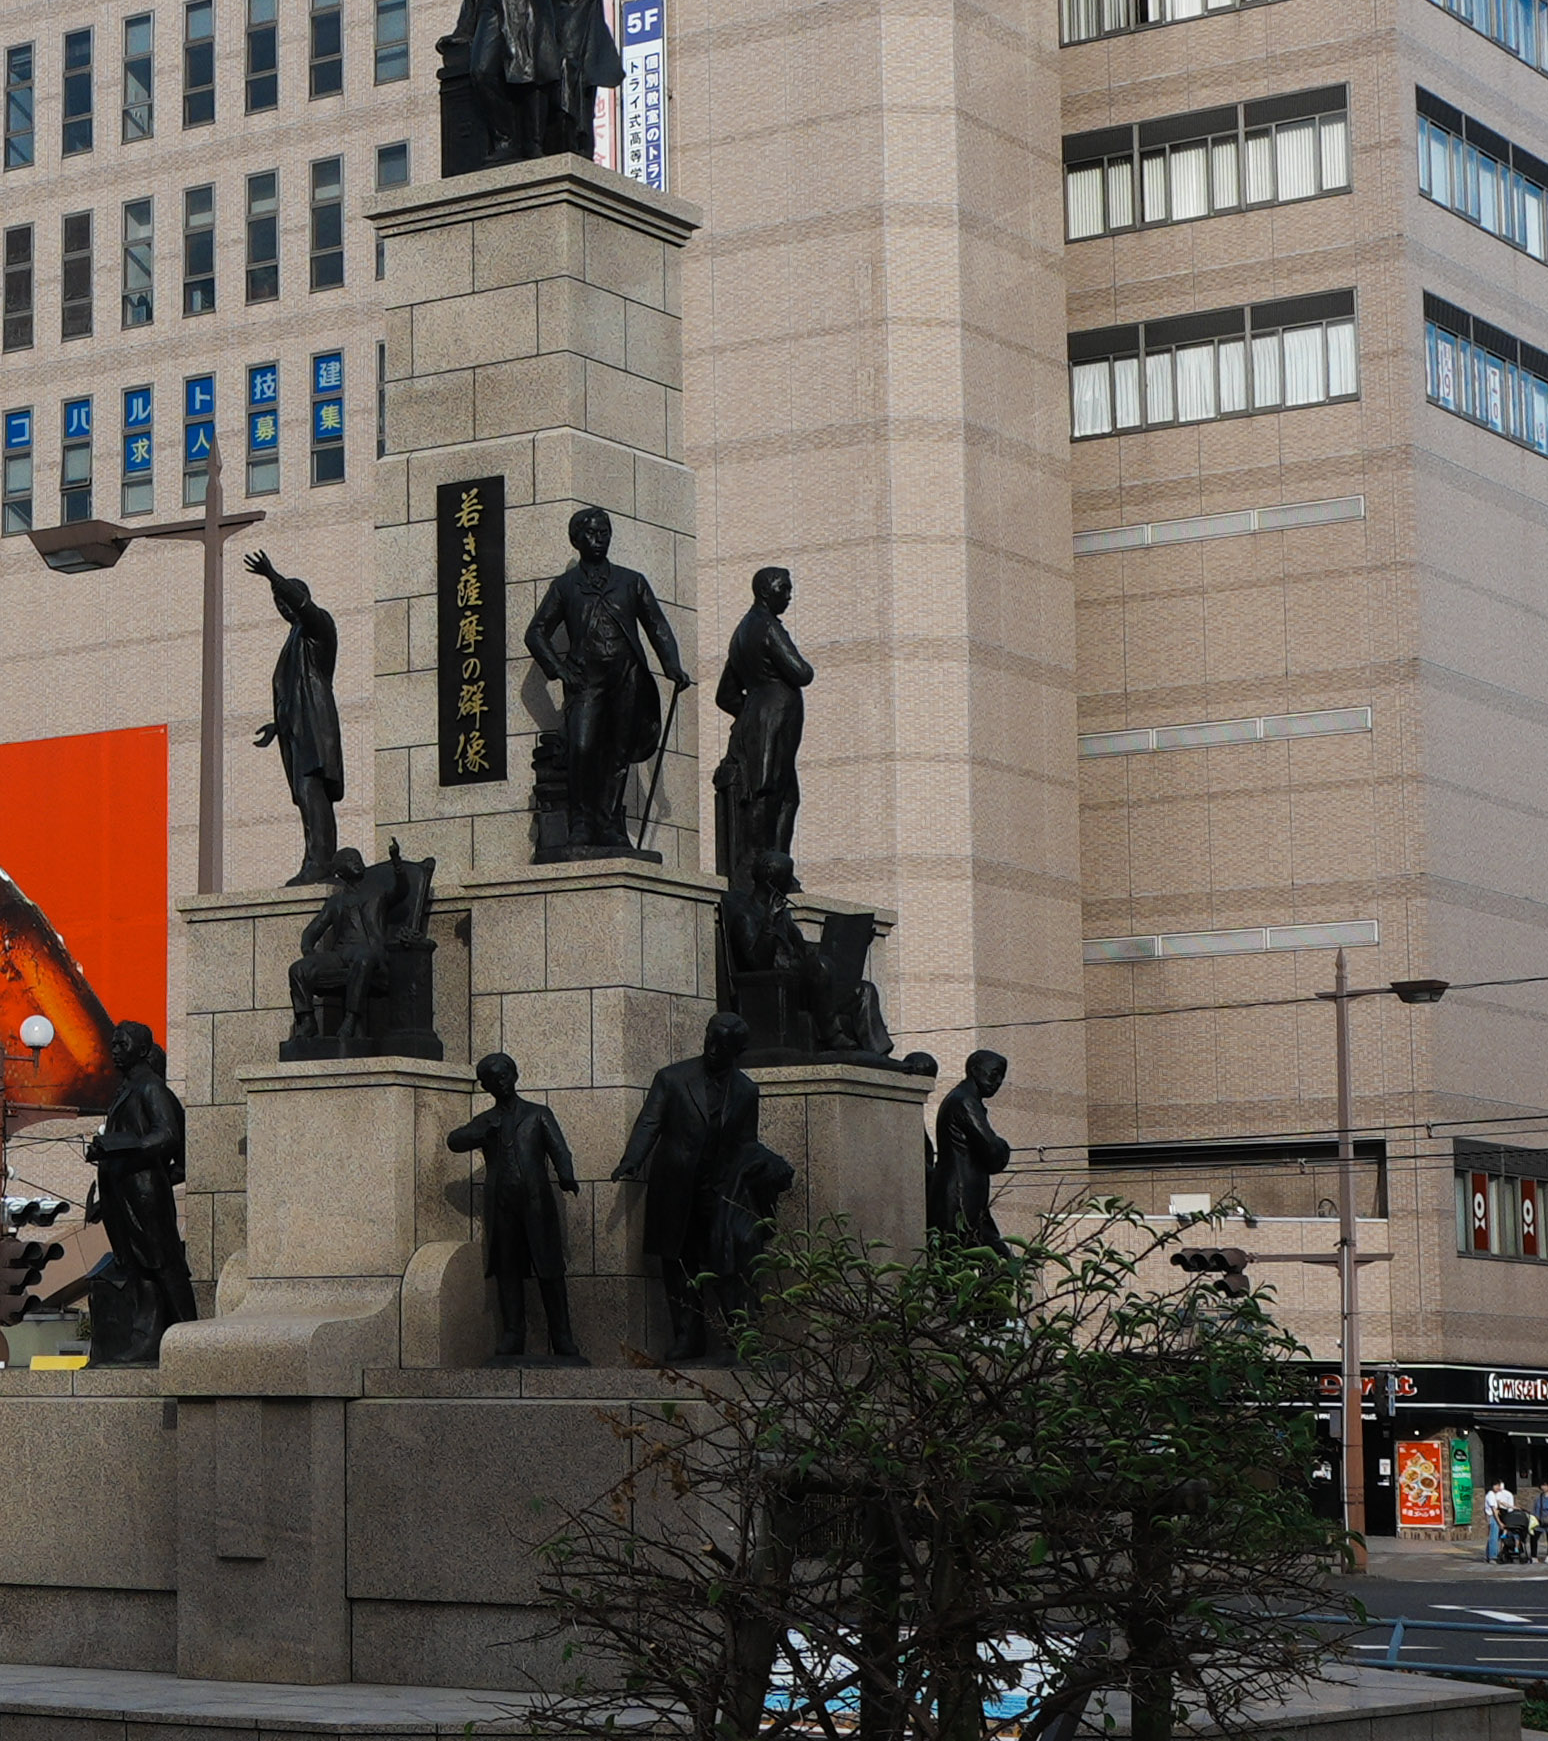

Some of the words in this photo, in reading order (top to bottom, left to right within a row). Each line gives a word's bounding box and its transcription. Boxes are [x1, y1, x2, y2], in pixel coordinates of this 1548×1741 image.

[626, 8, 659, 35] 5F
[453, 487, 490, 775] 若き薩摩の群像
